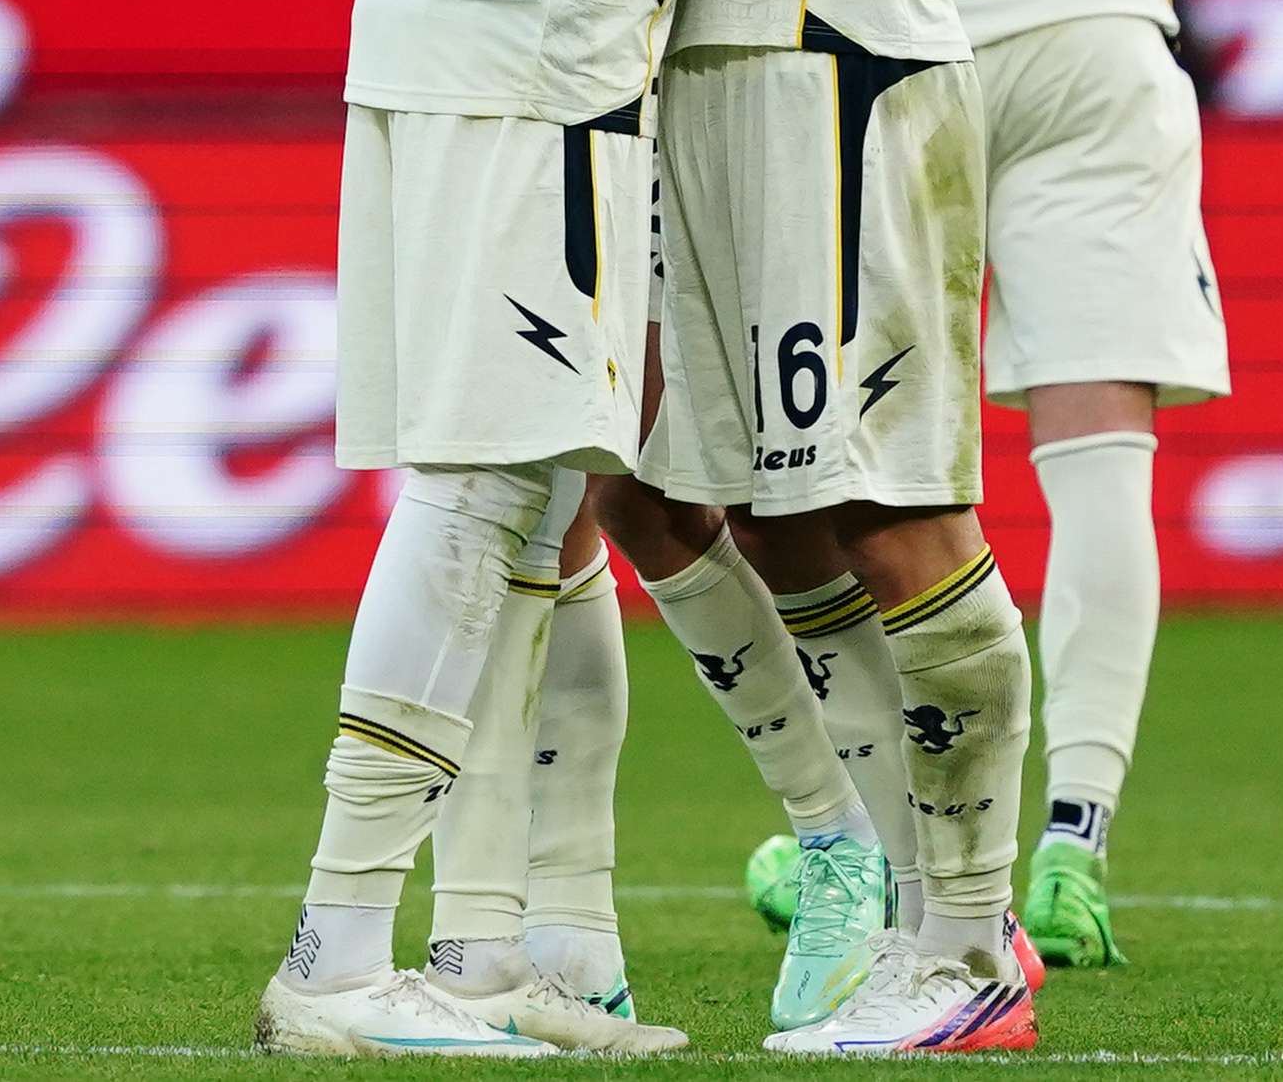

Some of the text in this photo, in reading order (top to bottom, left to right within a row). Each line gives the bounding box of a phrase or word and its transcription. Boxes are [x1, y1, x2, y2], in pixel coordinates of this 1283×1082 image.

[751, 322, 828, 431] 16
[735, 717, 787, 740] us
[835, 744, 875, 760] us
